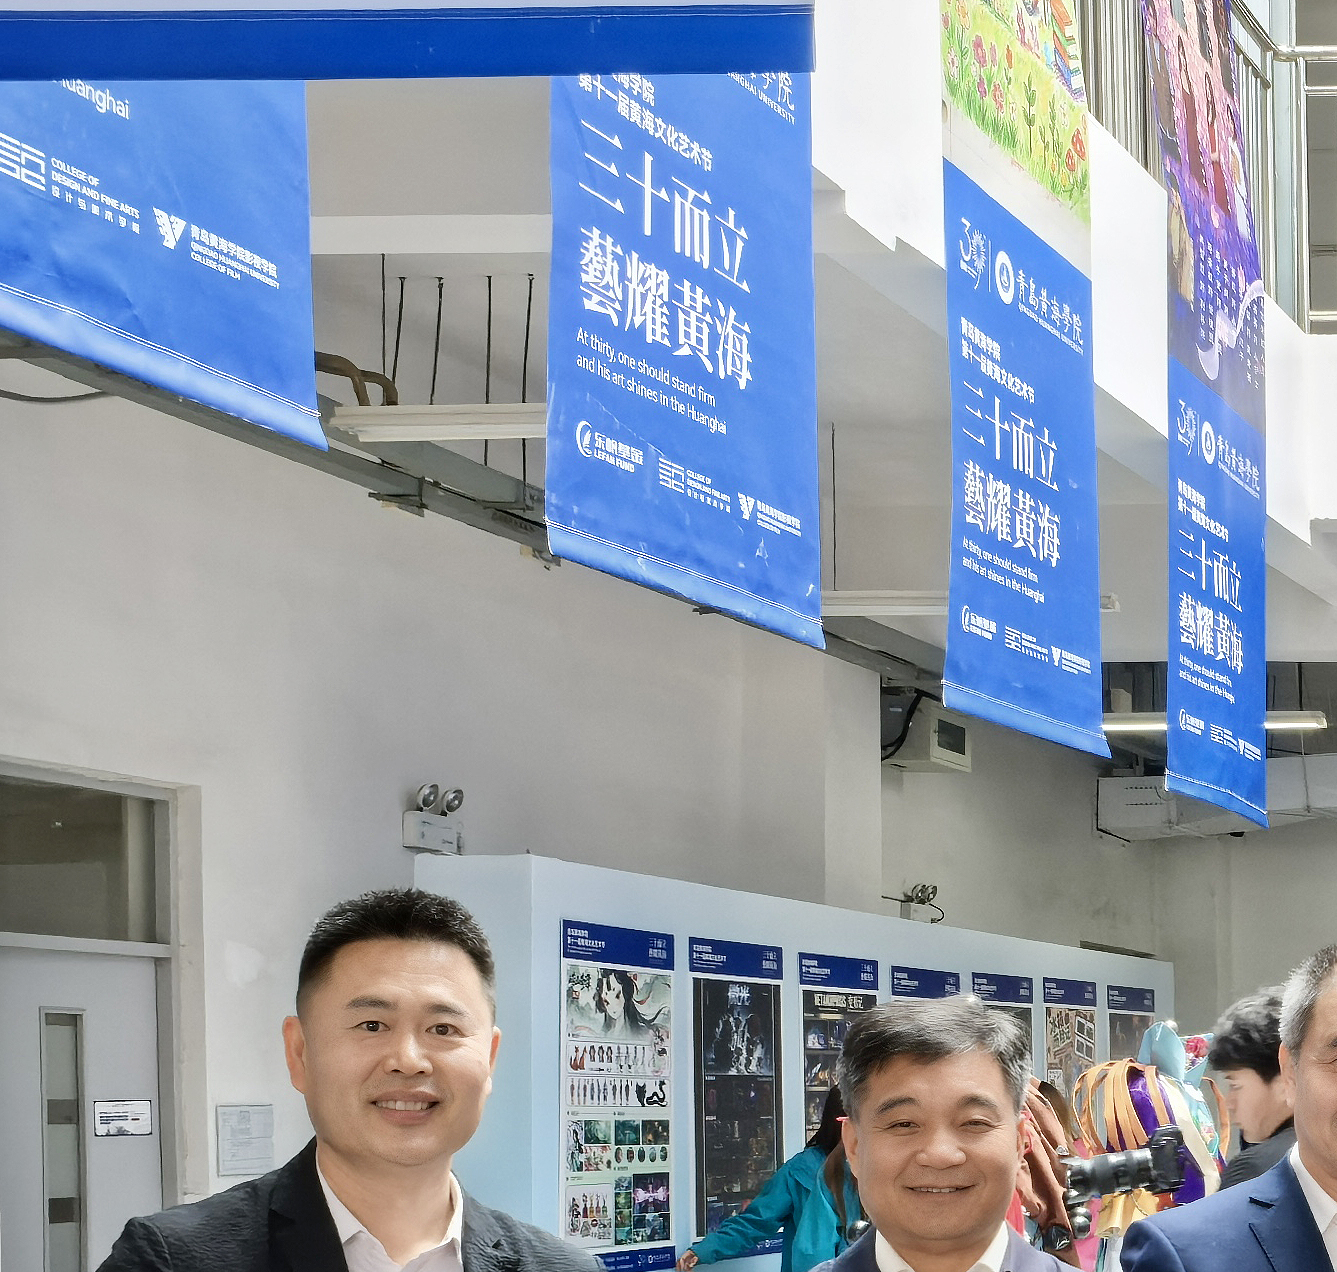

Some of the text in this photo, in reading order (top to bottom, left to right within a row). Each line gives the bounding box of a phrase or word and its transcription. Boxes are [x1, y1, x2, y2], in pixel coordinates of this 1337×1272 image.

[51, 158, 87, 182] COLLEGE
[51, 171, 139, 219] DESIGN AND FINE ARTS
[579, 119, 751, 294] 三十而立
[577, 327, 715, 407] At thirty, one should stand firm
[577, 355, 726, 434] and his art shines in the Huanghai
[962, 380, 1059, 492] 三十而立
[1177, 528, 1243, 613] 三十而立
